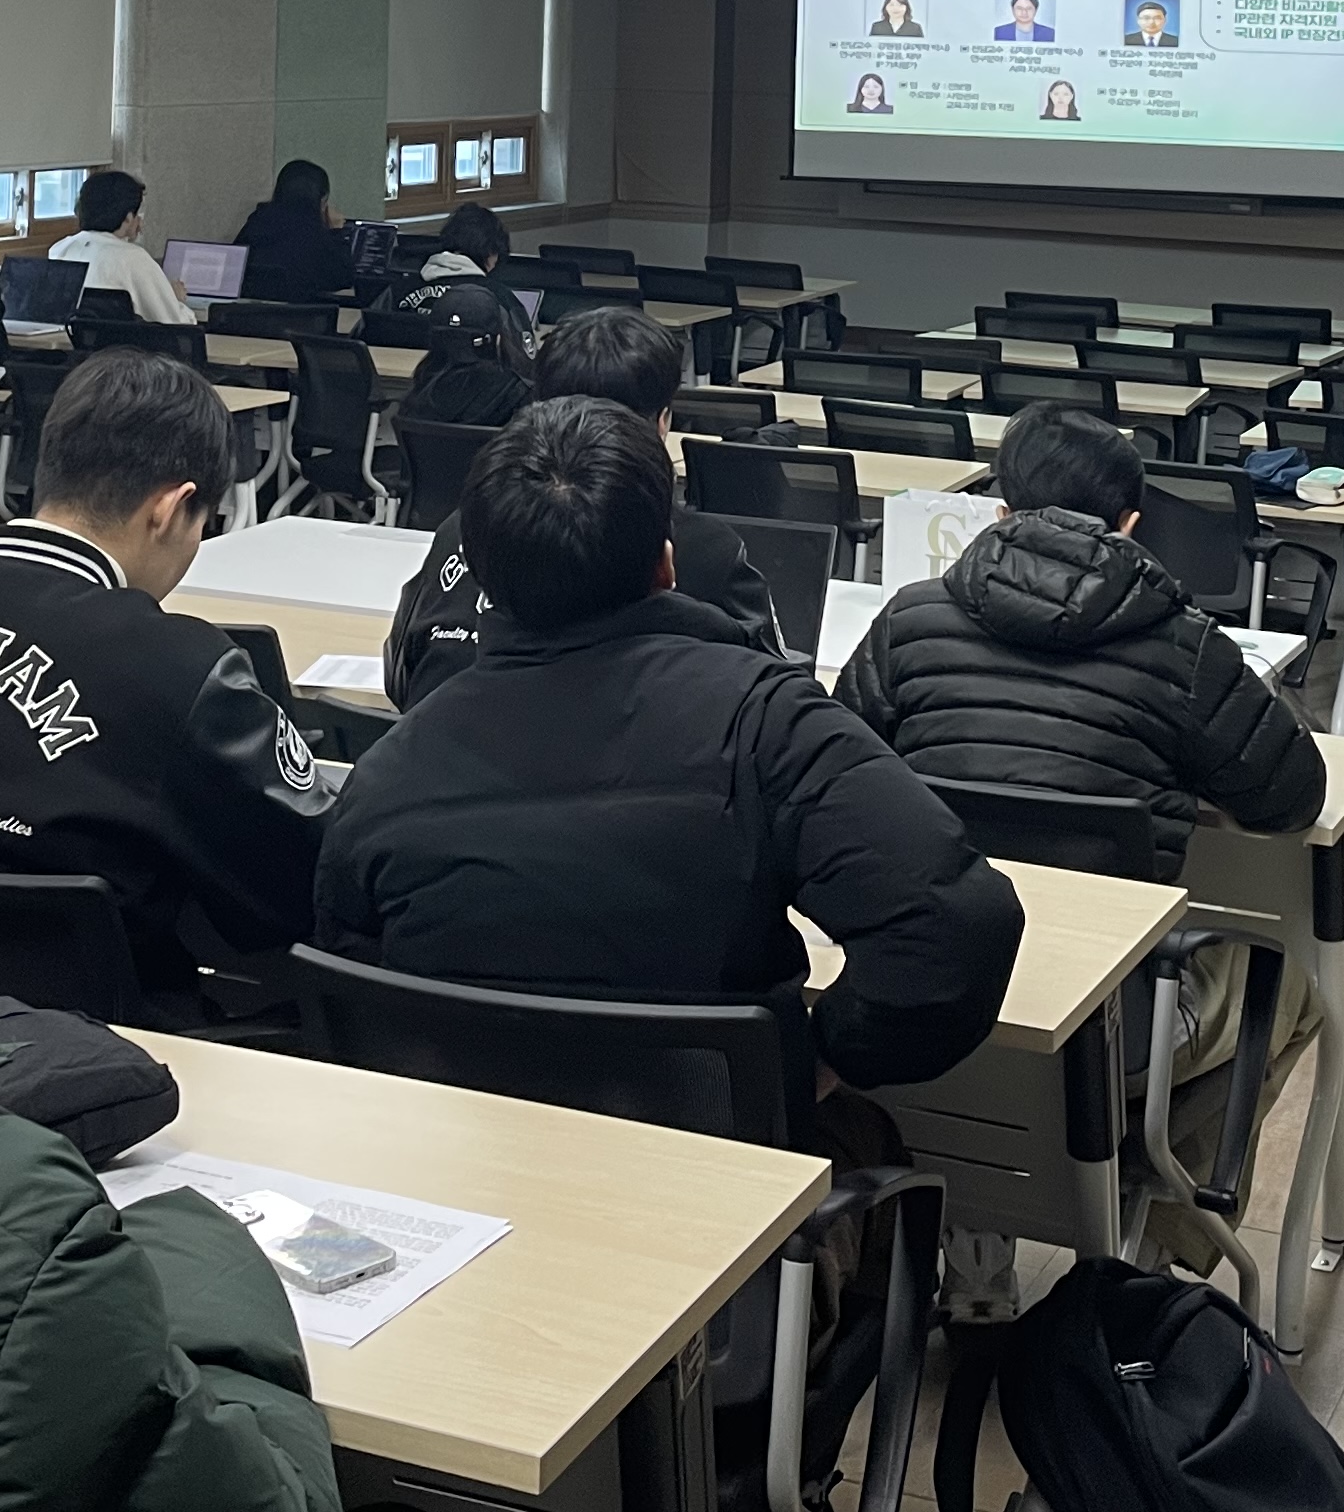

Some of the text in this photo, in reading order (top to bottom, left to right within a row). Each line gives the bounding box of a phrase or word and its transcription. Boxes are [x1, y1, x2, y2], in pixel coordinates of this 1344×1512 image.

[1234, 12, 1338, 27] IP관련 자격지원
[1233, 27, 1277, 40] 국내외
[1280, 28, 1294, 39] IP
